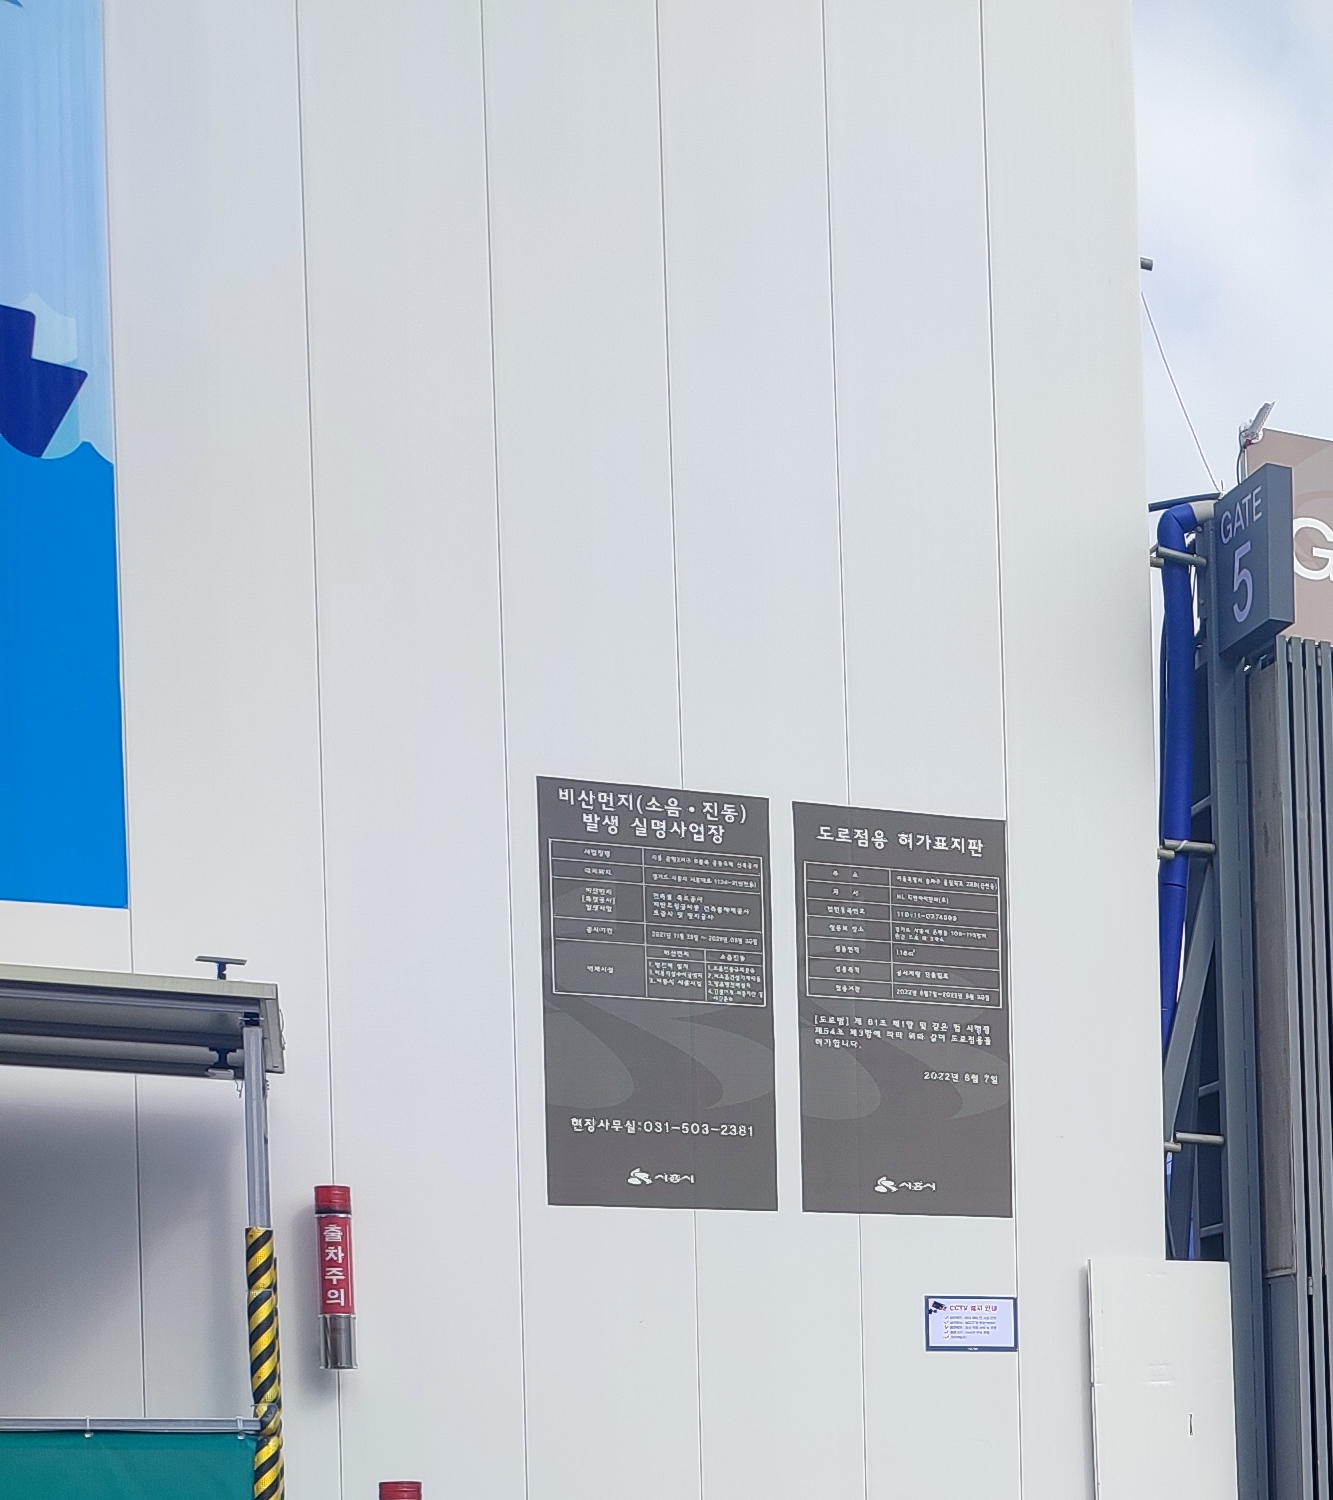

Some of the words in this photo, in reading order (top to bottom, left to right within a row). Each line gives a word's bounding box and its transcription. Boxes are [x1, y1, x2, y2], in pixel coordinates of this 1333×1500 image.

[1220, 485, 1263, 545] GATE
[1231, 540, 1254, 624] 5
[582, 812, 619, 835] 발생
[630, 817, 725, 845] 실명사업장
[816, 825, 888, 850] 도로점용
[897, 832, 984, 858] 허가표지판
[322, 1223, 345, 1307] 출차주의
